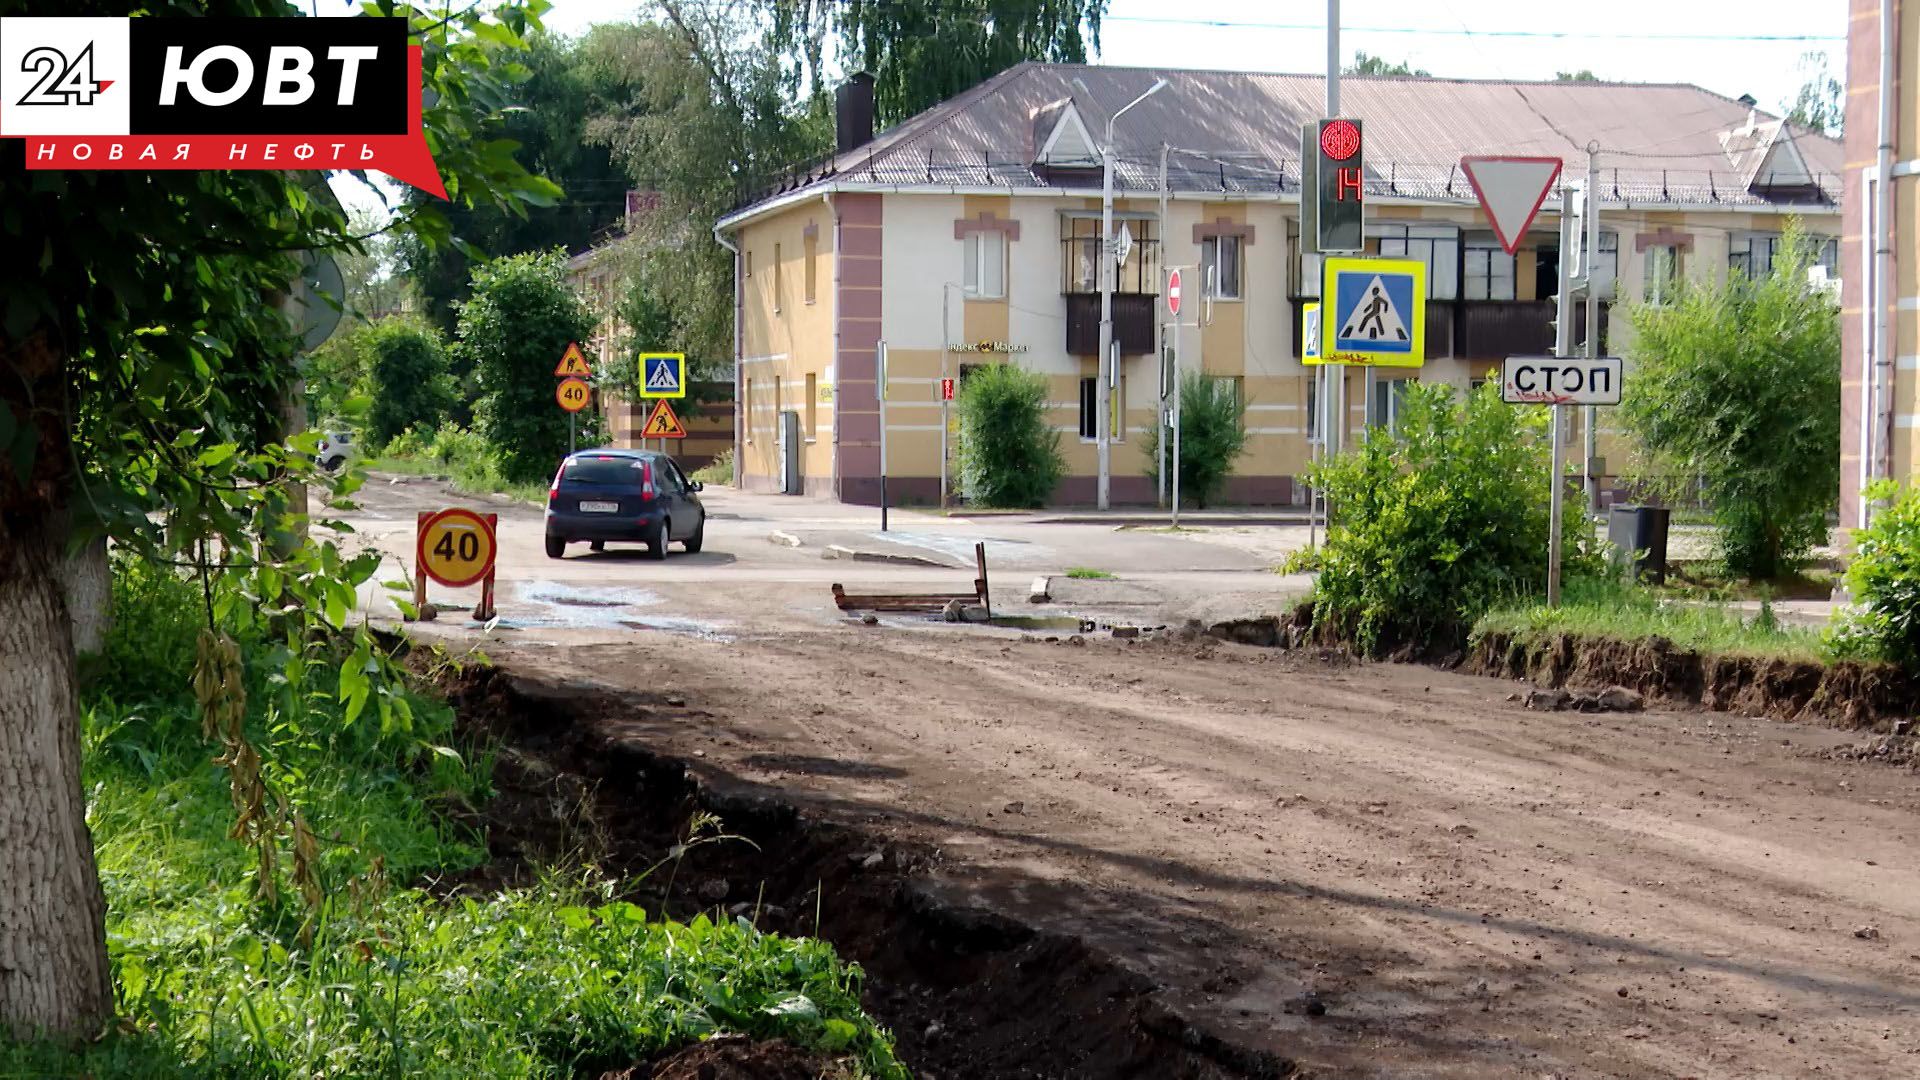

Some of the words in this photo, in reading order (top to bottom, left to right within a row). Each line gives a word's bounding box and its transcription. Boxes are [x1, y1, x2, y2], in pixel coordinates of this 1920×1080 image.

[1338, 168, 1362, 201] 14
[1514, 365, 1610, 393] СТОП
[564, 387, 583, 401] 40
[433, 531, 480, 562] 40
